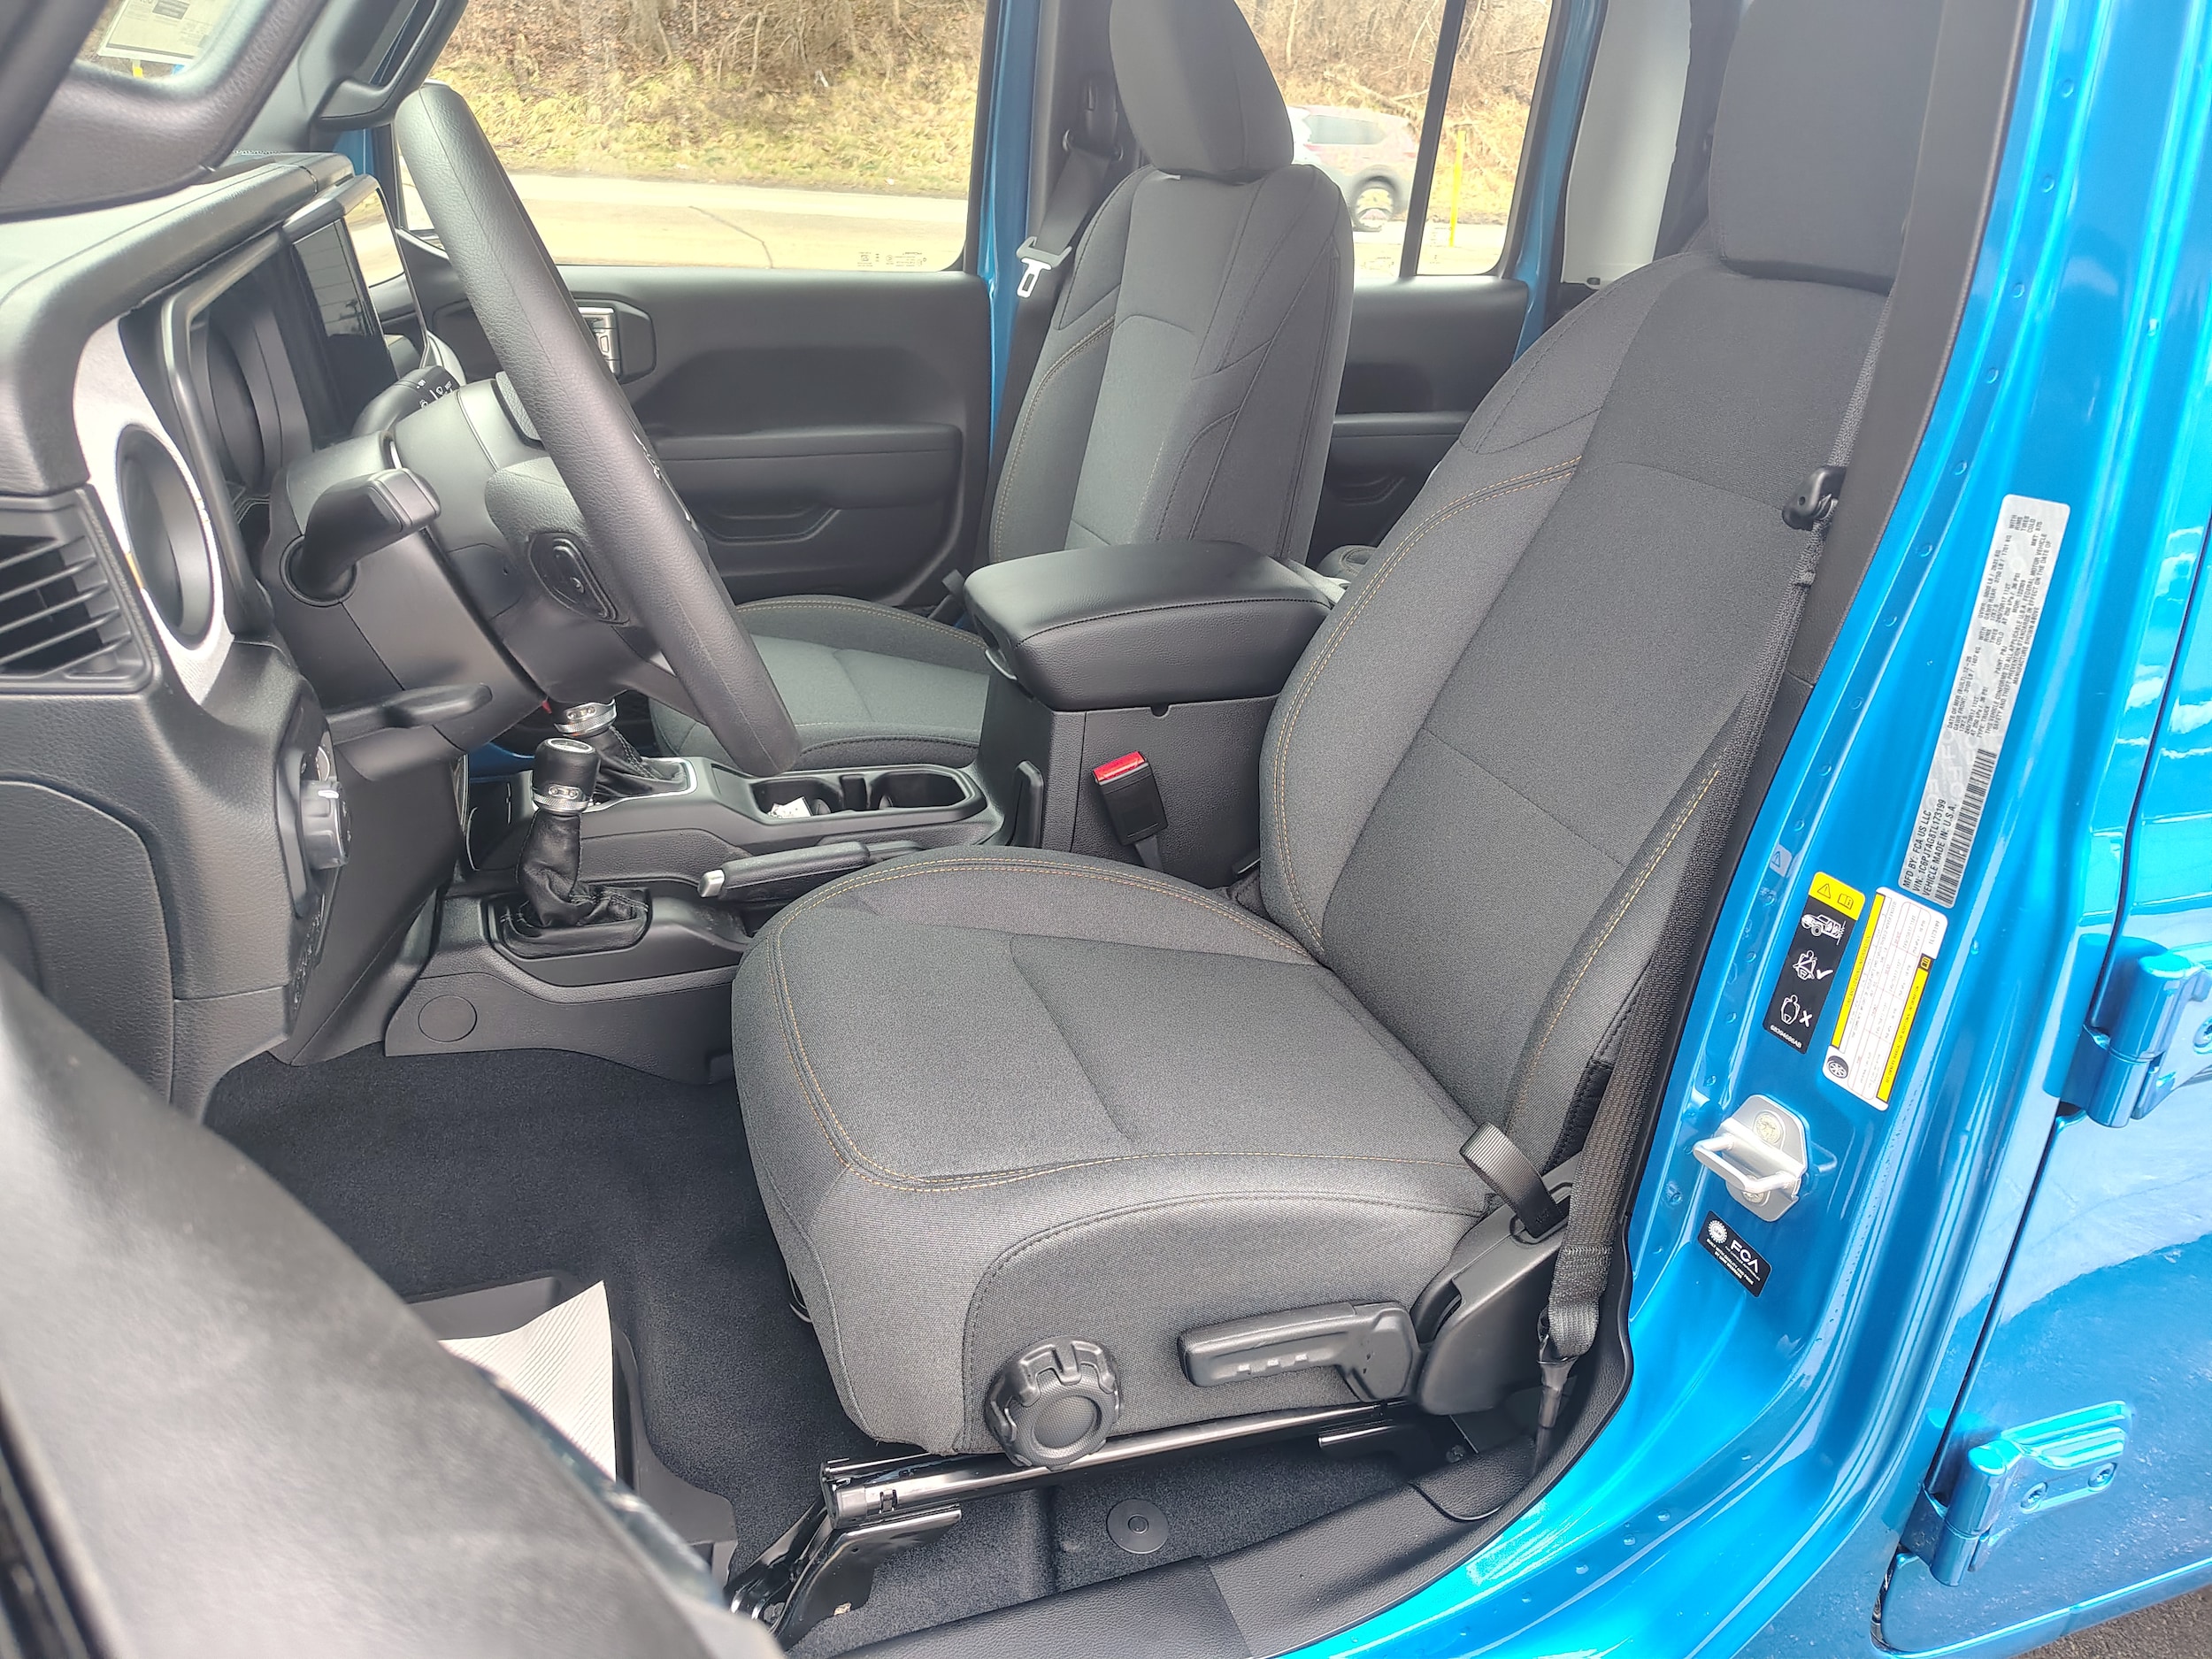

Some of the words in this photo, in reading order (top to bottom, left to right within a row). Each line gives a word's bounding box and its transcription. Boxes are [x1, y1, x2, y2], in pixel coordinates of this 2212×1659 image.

[2035, 533, 2047, 556] VEHICLE
[2044, 540, 2052, 549] OF
[2039, 549, 2049, 563] DATE
[2029, 557, 2040, 576] MOTOR
[2036, 565, 2045, 576] THE
[2033, 576, 2041, 585] ON
[2022, 578, 2034, 602] FEDERAL
[2027, 586, 2039, 606] EFFECT
[1978, 626, 1986, 641] WITH
[1983, 627, 1992, 642] RIMS
[1995, 631, 2004, 645] COLD
[2008, 619, 2023, 651] APPLICABLE
[2016, 614, 2031, 646] STANDARDS
[2007, 646, 2021, 680] PREVENTION
[2012, 645, 2029, 685] MANUFACTURE
[1994, 671, 2008, 700] CONFORMS
[2001, 680, 2011, 697] THEFT
[1988, 700, 2000, 721] VEHICLE
[1998, 697, 2007, 710] AND
[1947, 714, 1955, 729] DATE
[1980, 704, 1990, 722] TRUCK
[1992, 710, 2003, 730] SAFETY
[1985, 721, 1993, 734] THIS
[1920, 809, 1932, 825] LLC
[1942, 801, 1956, 826] U.S.A.
[1916, 825, 1927, 837] US
[1917, 797, 1946, 874] 1C6PJTAG8TL173199
[1938, 826, 1949, 840] IN:
[1912, 838, 1924, 854] FCA
[1931, 840, 1945, 864] MADE
[1907, 855, 1918, 870] BY:
[1902, 869, 1914, 888] MFD
[1912, 875, 1924, 893] VIN:
[1922, 864, 1938, 896] VEHICLE
[1731, 1239, 1758, 1273] FCA
